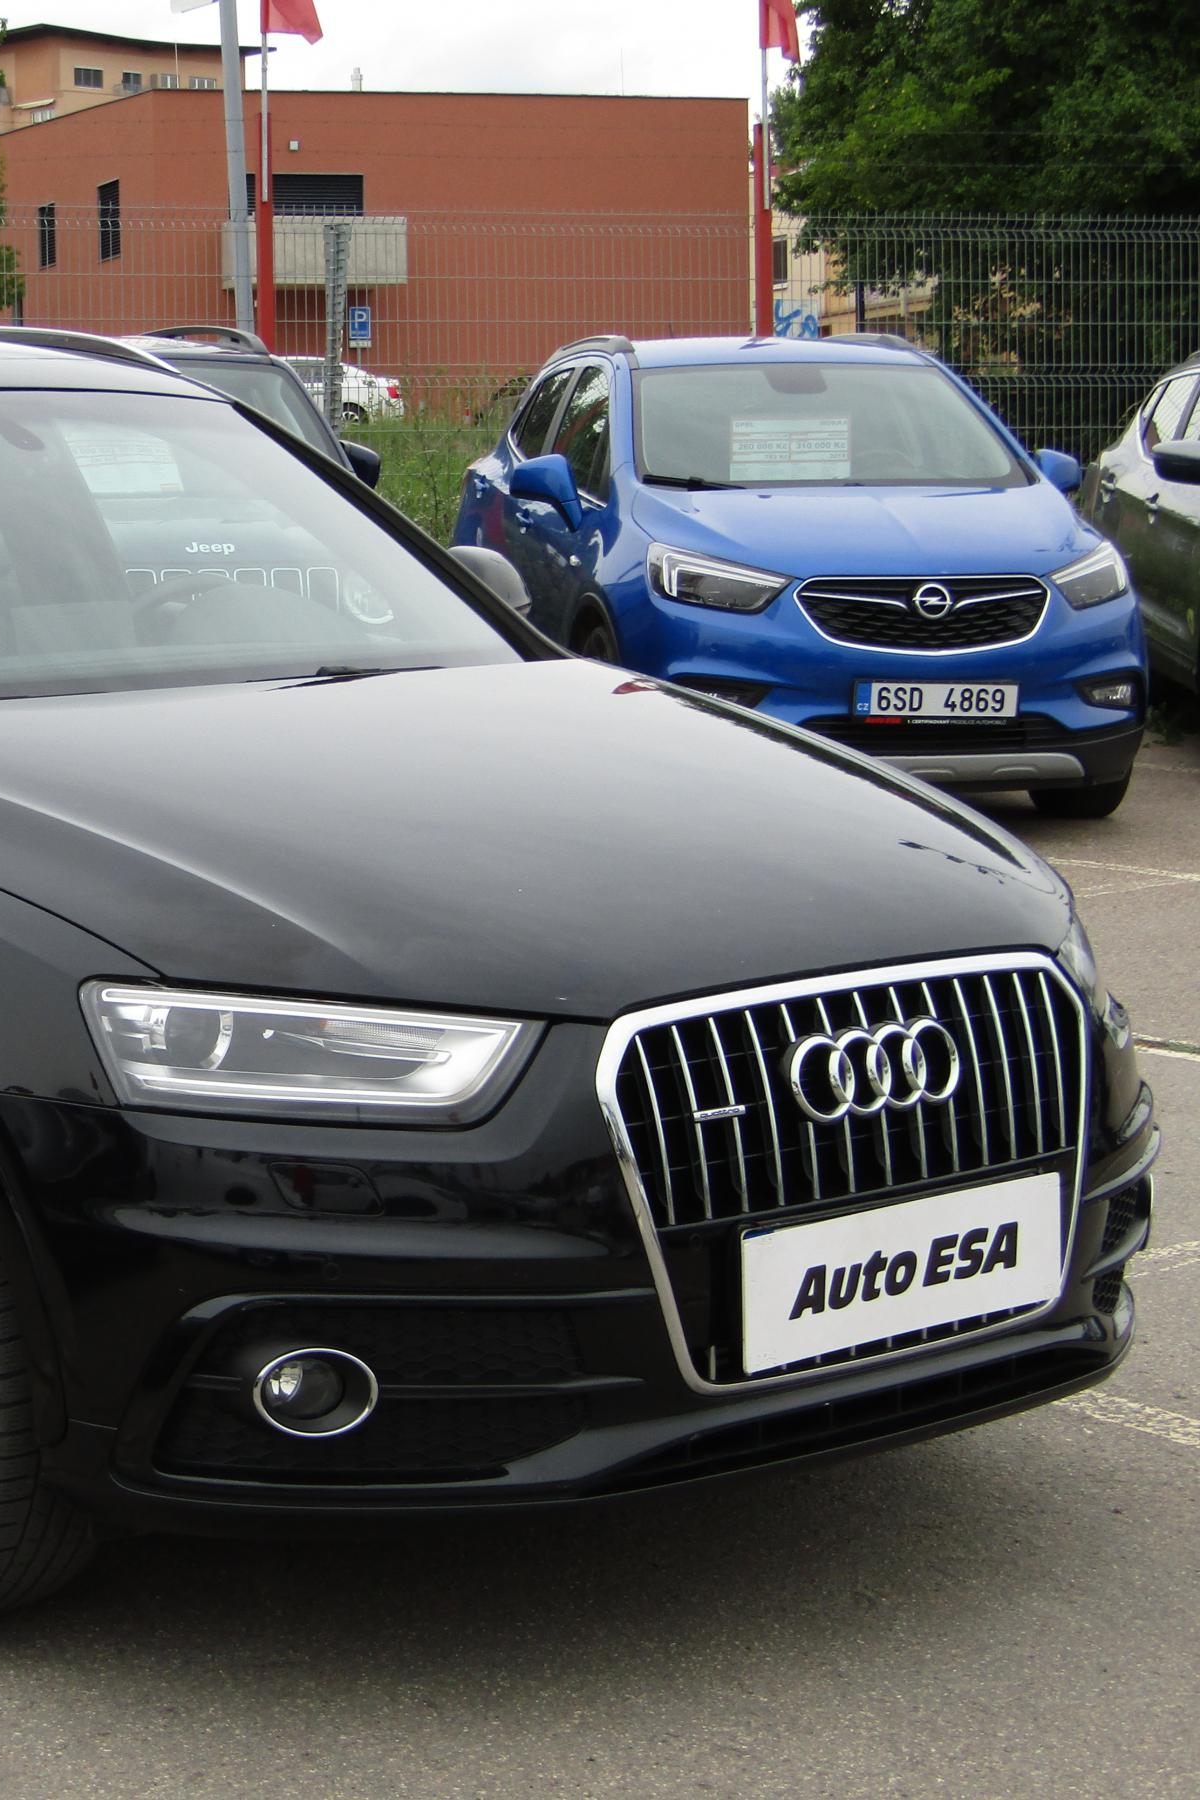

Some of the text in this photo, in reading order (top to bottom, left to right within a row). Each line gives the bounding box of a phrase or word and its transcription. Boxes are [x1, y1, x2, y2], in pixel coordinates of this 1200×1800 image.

[355, 310, 367, 329] P
[185, 541, 235, 556] Jeep
[856, 702, 869, 711] CZ
[877, 686, 1006, 713] 6SD 4869
[788, 1221, 1018, 1320] Auto ESA
